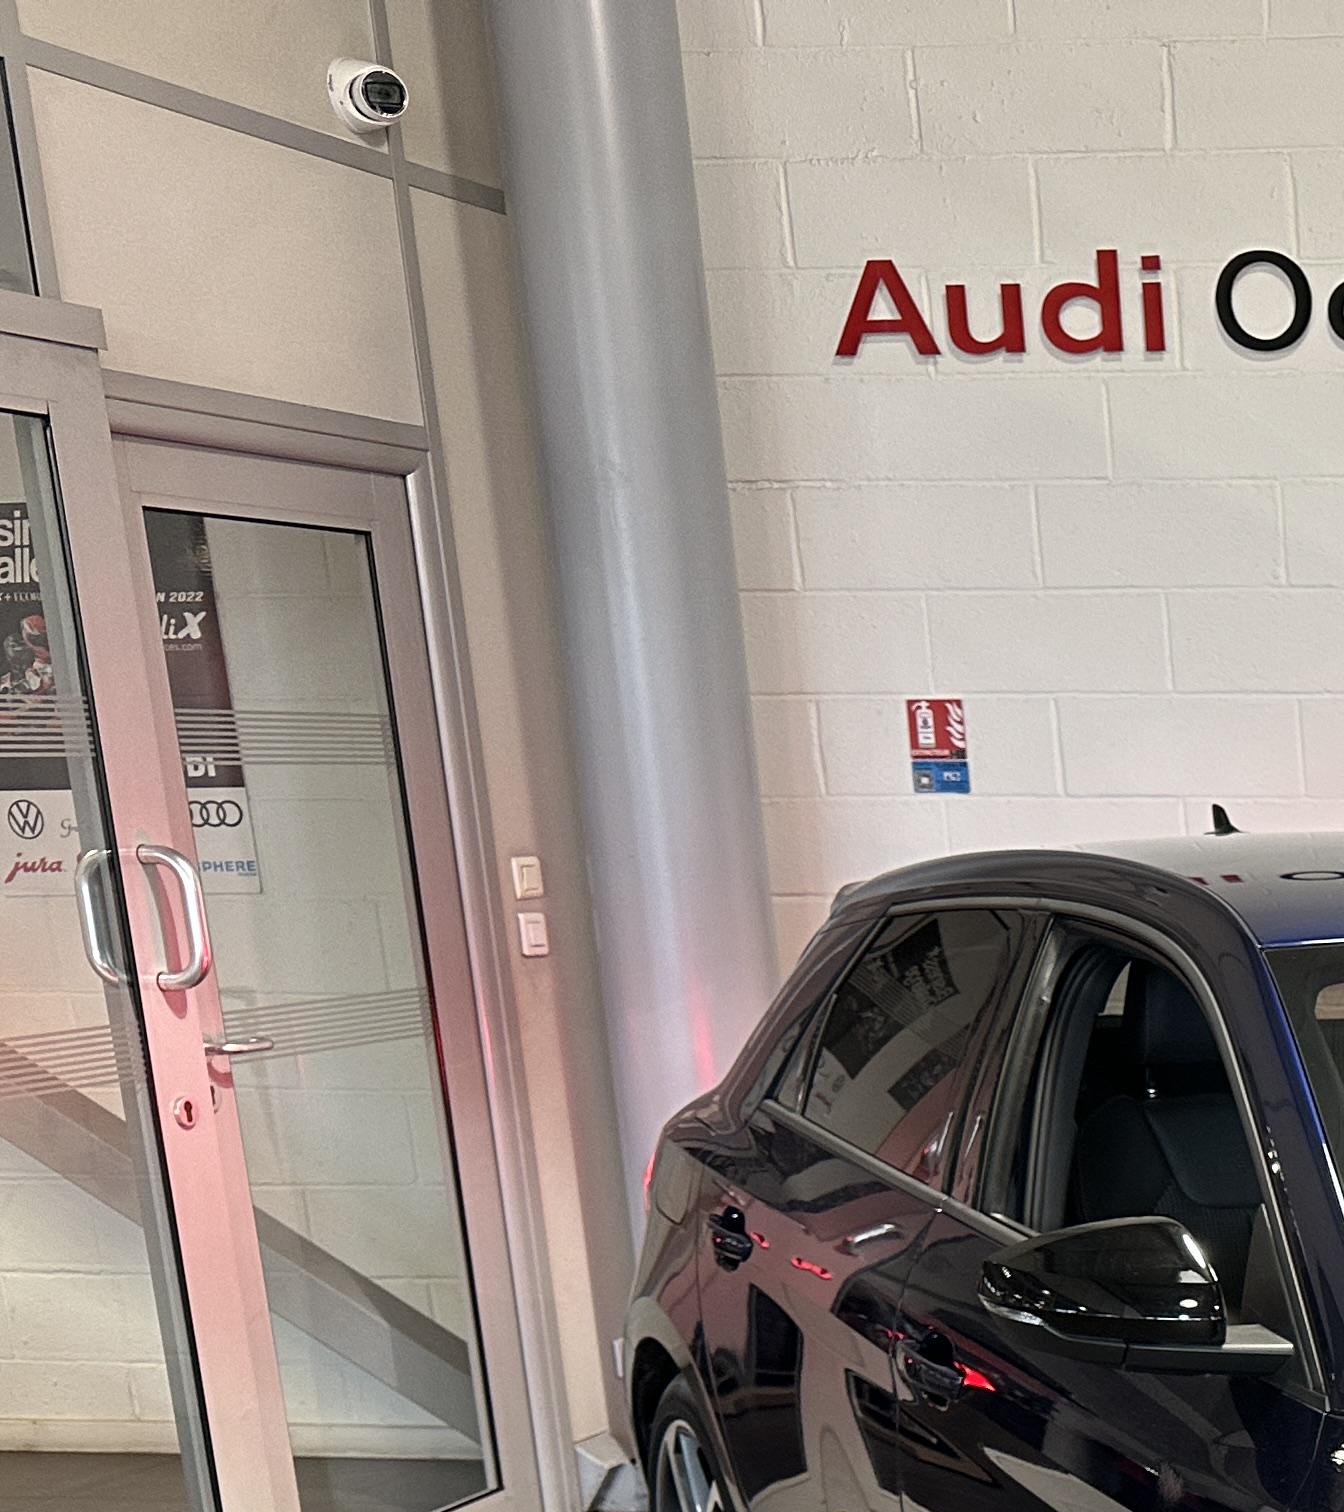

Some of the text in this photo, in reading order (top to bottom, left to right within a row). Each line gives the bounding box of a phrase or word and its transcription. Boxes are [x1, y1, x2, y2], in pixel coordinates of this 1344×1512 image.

[836, 250, 1166, 357] Audi
[169, 591, 204, 602] 2022
[5, 852, 63, 884] jura
